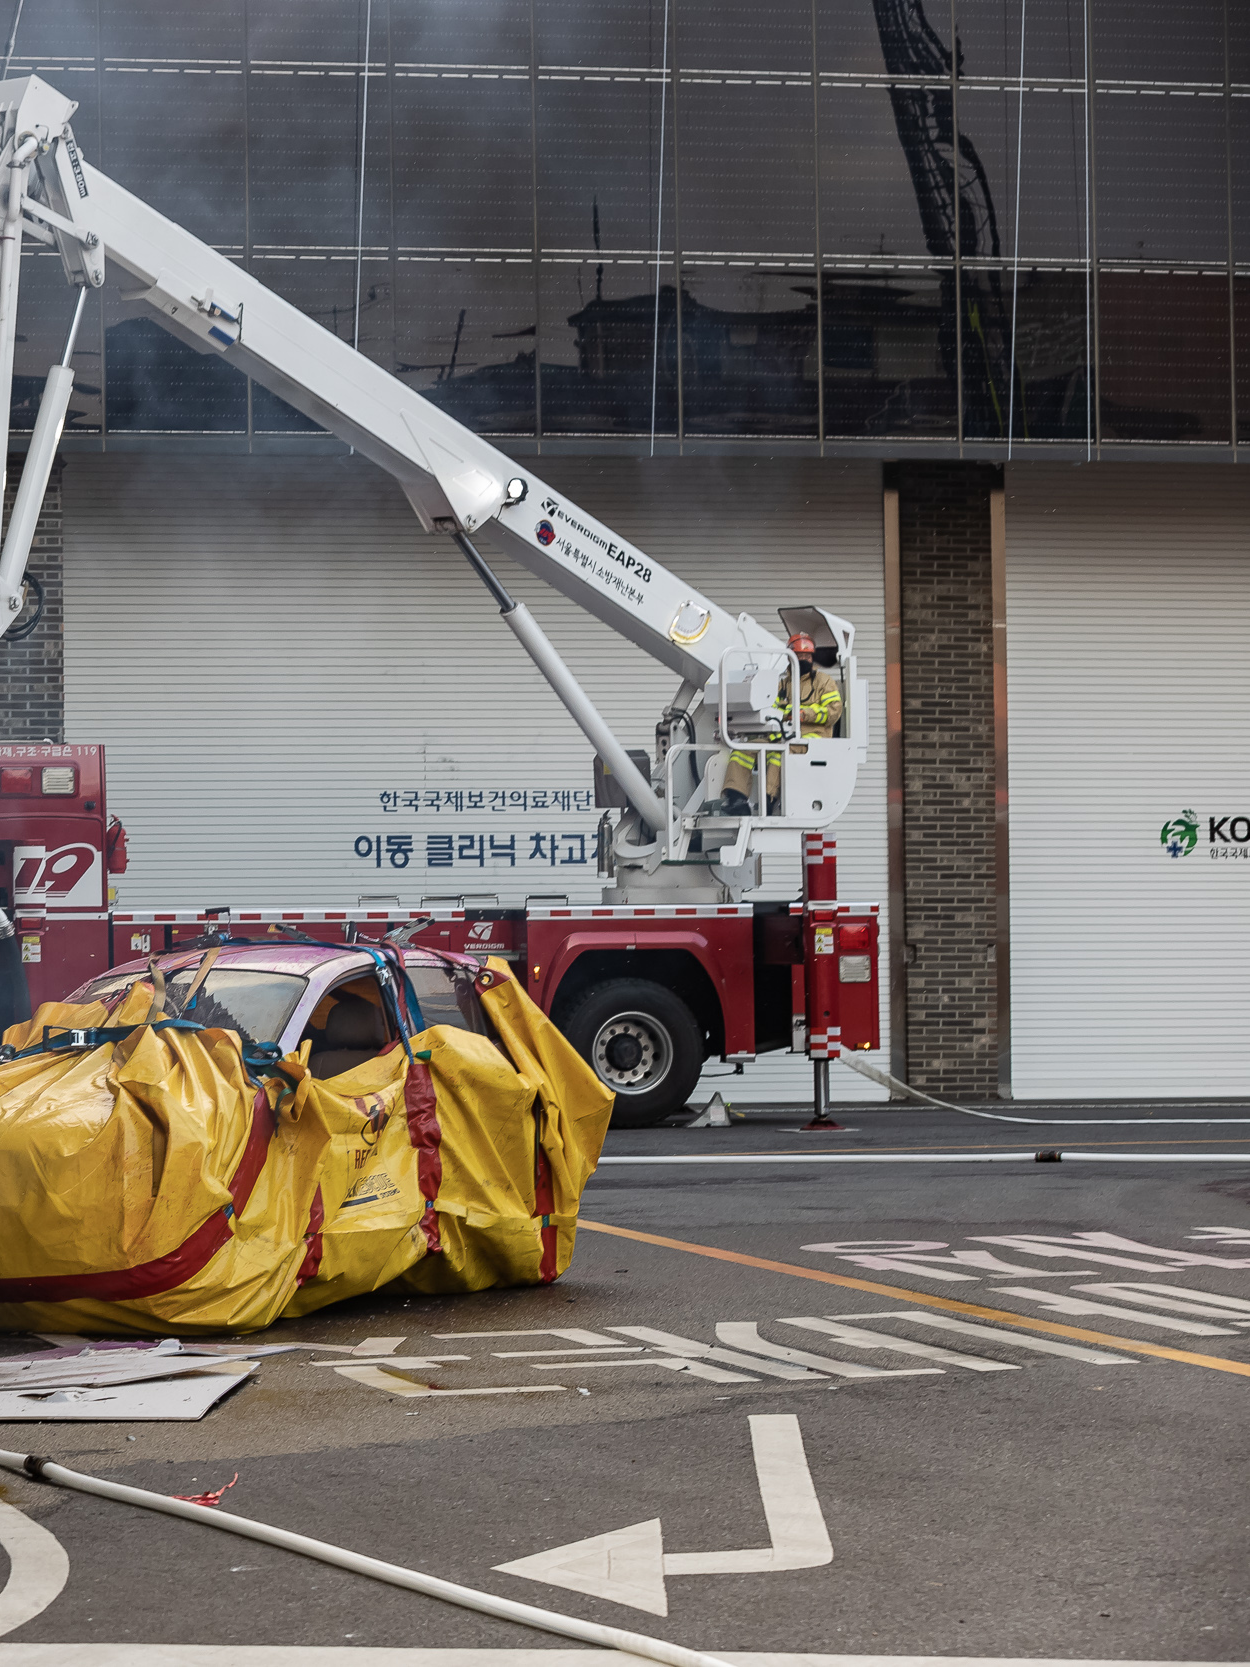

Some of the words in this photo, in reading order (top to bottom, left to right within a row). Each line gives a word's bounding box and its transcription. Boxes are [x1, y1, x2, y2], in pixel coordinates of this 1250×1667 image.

[556, 537, 597, 574] 서울특별시
[607, 542, 652, 583] EAP28
[76, 746, 97, 756] 119
[379, 790, 593, 813] 한국국제보건의료재단
[1209, 816, 1250, 843] KO
[354, 834, 414, 868] 이동
[426, 834, 516, 868] 클리닉
[1210, 847, 1250, 859] 한국국제
[14, 846, 95, 898] 119
